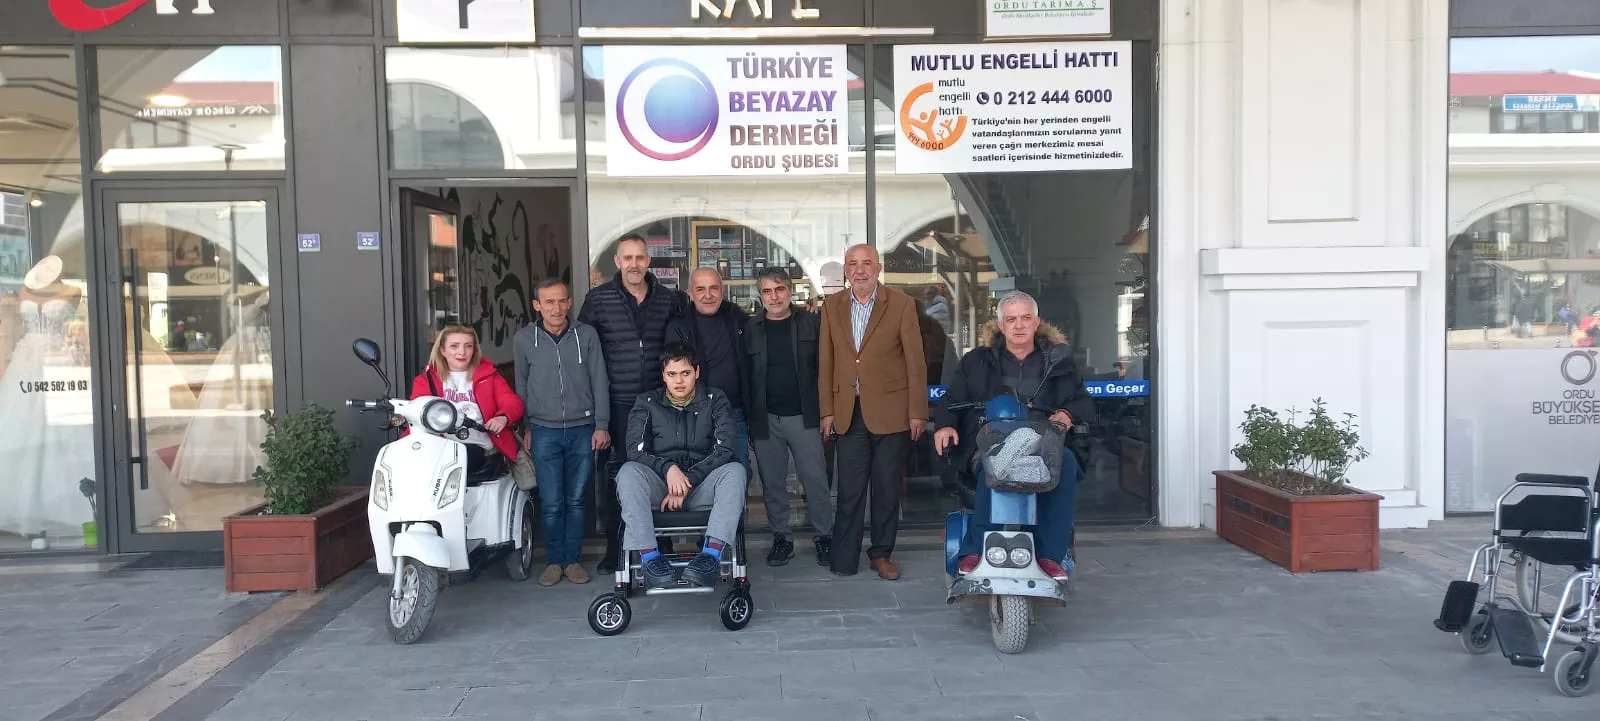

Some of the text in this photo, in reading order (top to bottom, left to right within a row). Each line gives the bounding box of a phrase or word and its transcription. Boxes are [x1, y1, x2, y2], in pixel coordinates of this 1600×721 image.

[726, 52, 833, 79] TÜRKİYE
[911, 49, 1119, 71] MUTLU ENGELLİ HATTI
[938, 77, 965, 87] mutlu
[729, 90, 837, 113] BEYAZAY
[938, 92, 971, 103] engelli
[993, 89, 1113, 105] 0 212 444 6000
[972, 115, 1112, 126] Türkiye'nin her yerinden engelli
[729, 118, 838, 146] DERNEĞİ
[972, 127, 1122, 138] vatandaşlarımızın sorularına yanıt
[920, 141, 944, 150] 6000
[999, 141, 1022, 151] çağrı
[1024, 140, 1075, 148] merkezimiz
[1077, 139, 1104, 147] mesai
[731, 155, 776, 169] ORDU
[972, 151, 1124, 163] saatleri içerisinde hizmetinizdedir.
[34, 381, 49, 392] 542
[1106, 383, 1145, 396] Geçer
[1563, 389, 1595, 399] ORDU
